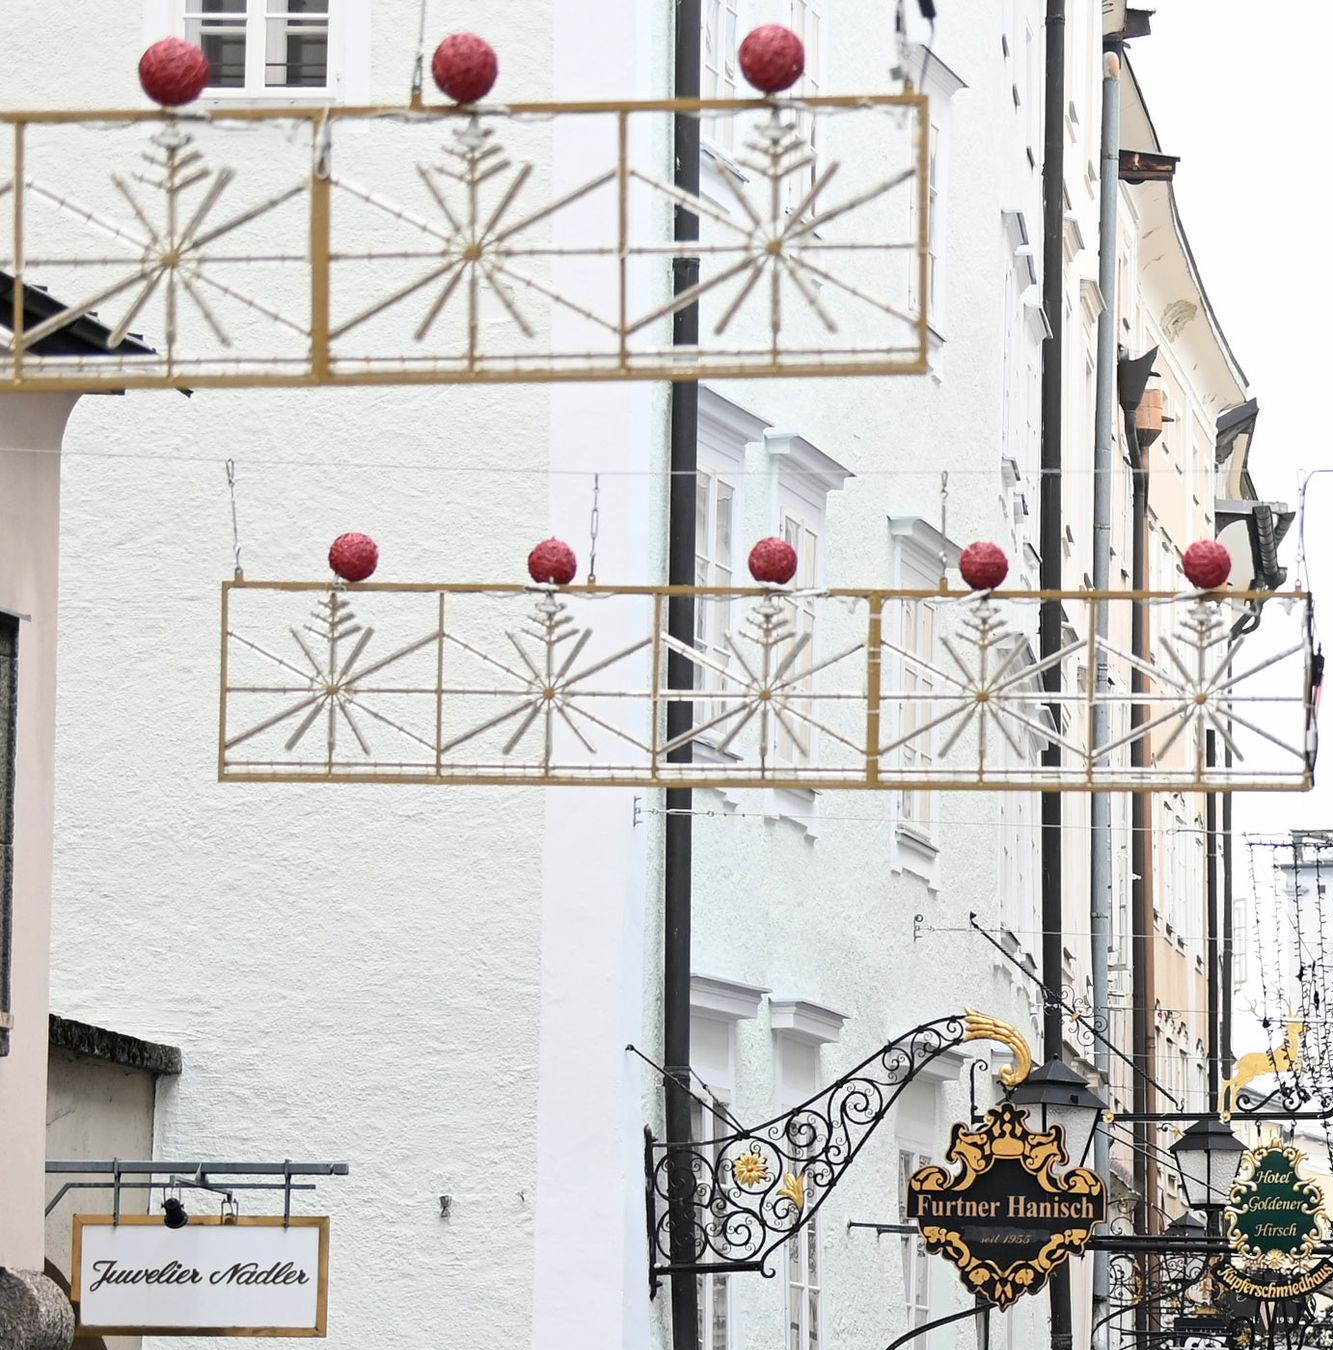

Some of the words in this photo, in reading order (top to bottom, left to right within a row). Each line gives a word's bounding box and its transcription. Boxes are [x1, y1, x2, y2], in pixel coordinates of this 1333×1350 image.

[1256, 1170, 1293, 1184] Hotel
[916, 1194, 1000, 1217] Furtner
[1007, 1195, 1094, 1219] Hanisch
[1248, 1195, 1304, 1212] Goldener
[1254, 1222, 1297, 1237] Hirsch
[979, 1233, 1001, 1244] seit
[1002, 1234, 1032, 1245] 1955
[89, 1260, 203, 1292] Juwelier
[209, 1261, 310, 1286] Nadler
[1217, 1263, 1333, 1298] Kupferschmiedhaus
